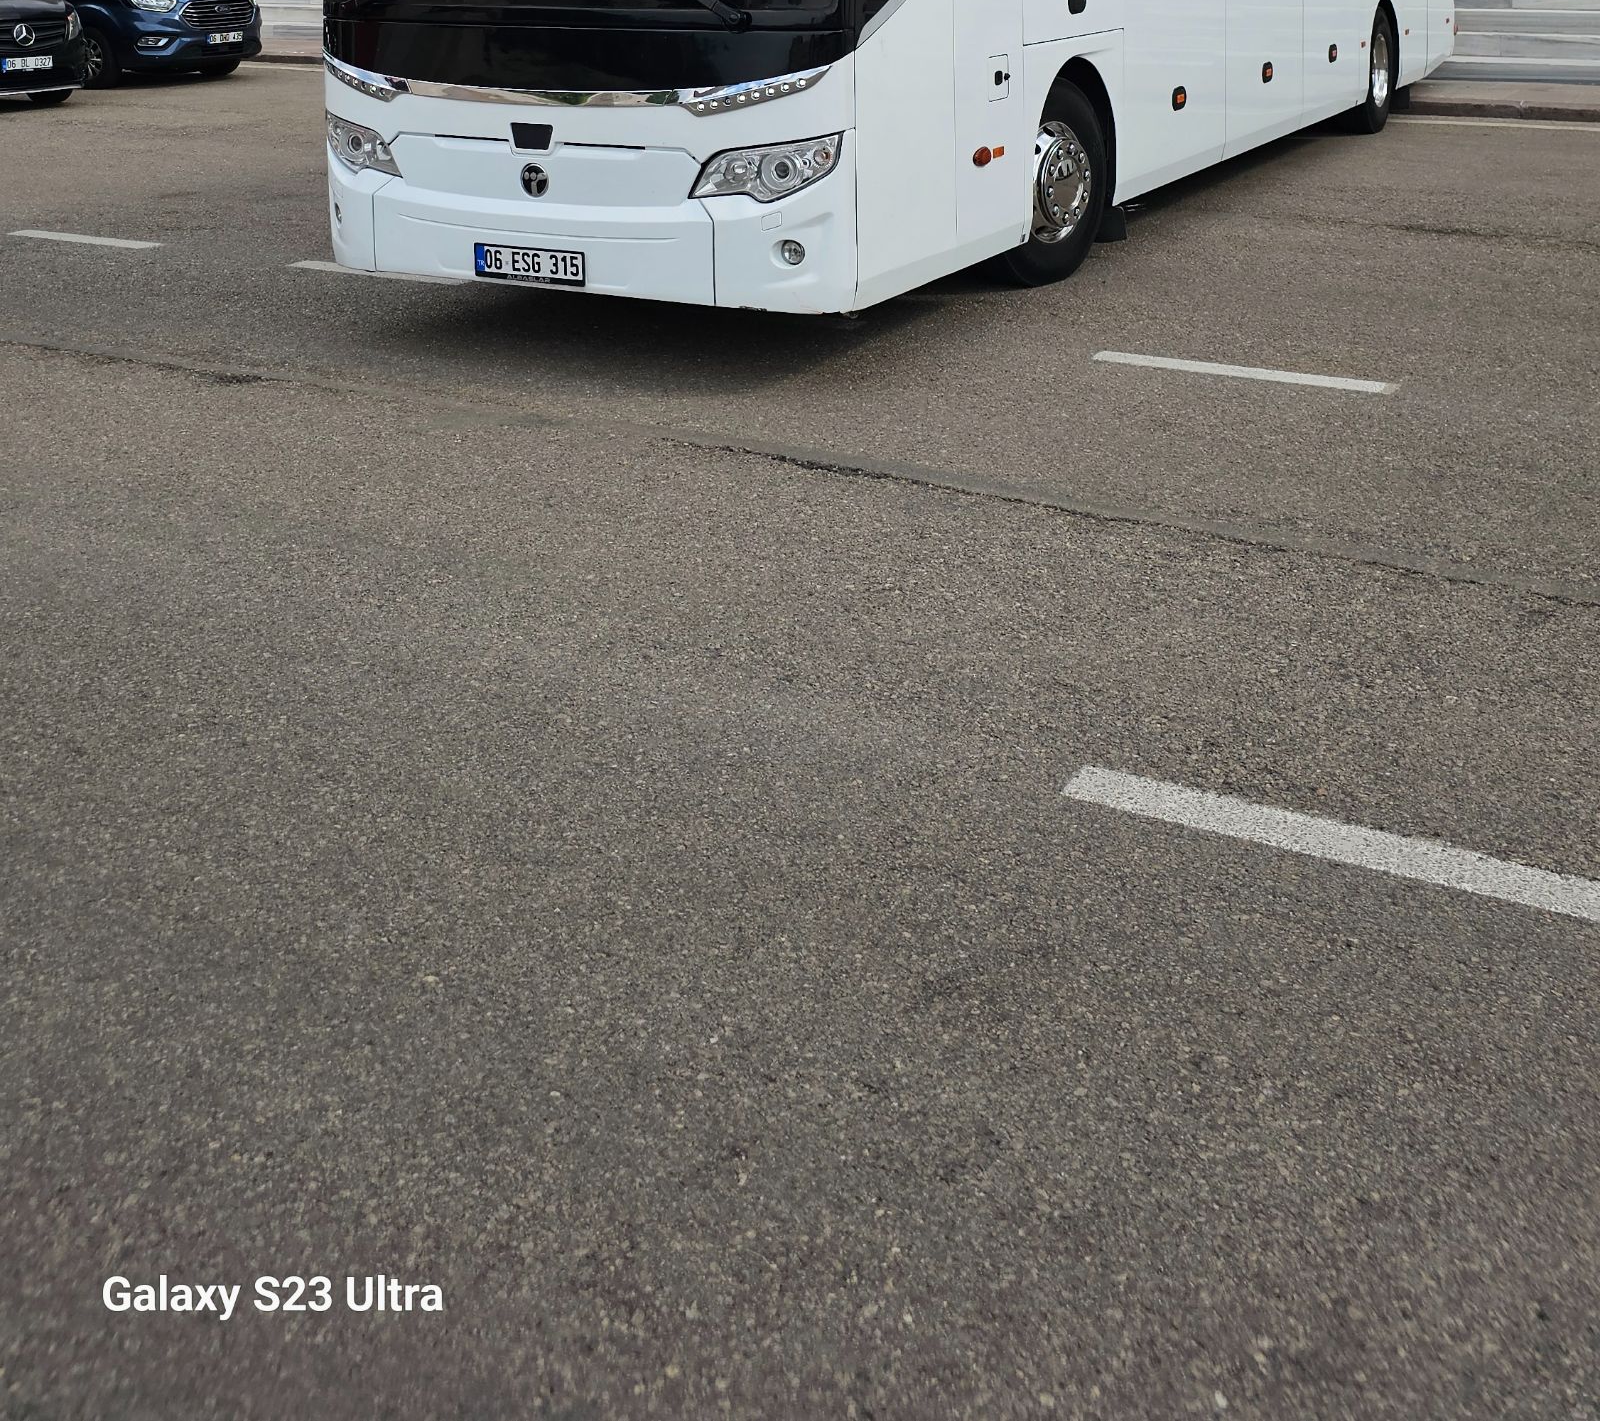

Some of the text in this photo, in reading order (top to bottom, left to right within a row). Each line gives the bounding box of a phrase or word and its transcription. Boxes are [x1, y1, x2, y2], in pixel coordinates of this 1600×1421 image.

[7, 59, 17, 69] 06
[484, 248, 580, 277] 06 ESG 315
